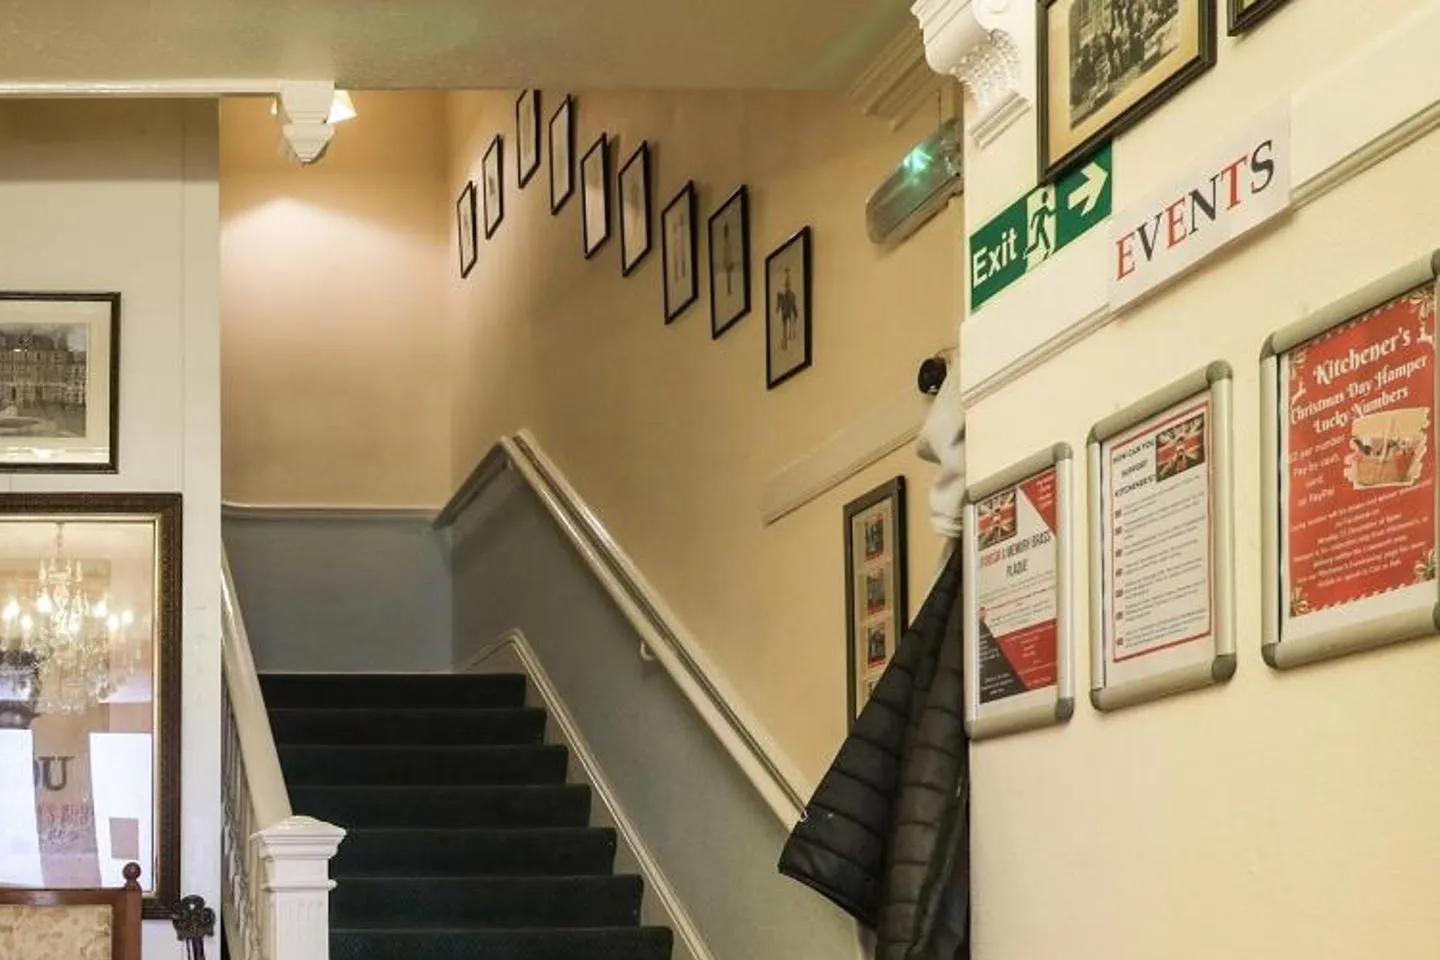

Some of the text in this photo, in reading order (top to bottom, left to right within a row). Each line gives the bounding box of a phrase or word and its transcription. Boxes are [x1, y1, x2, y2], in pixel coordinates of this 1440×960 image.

[1116, 139, 1274, 280] EVENTS
[973, 226, 1019, 288] Exit
[1313, 326, 1411, 385] Kitchener's
[1291, 355, 1428, 425] Christmas Day Hamper
[1313, 387, 1409, 433] Lucky Numbers
